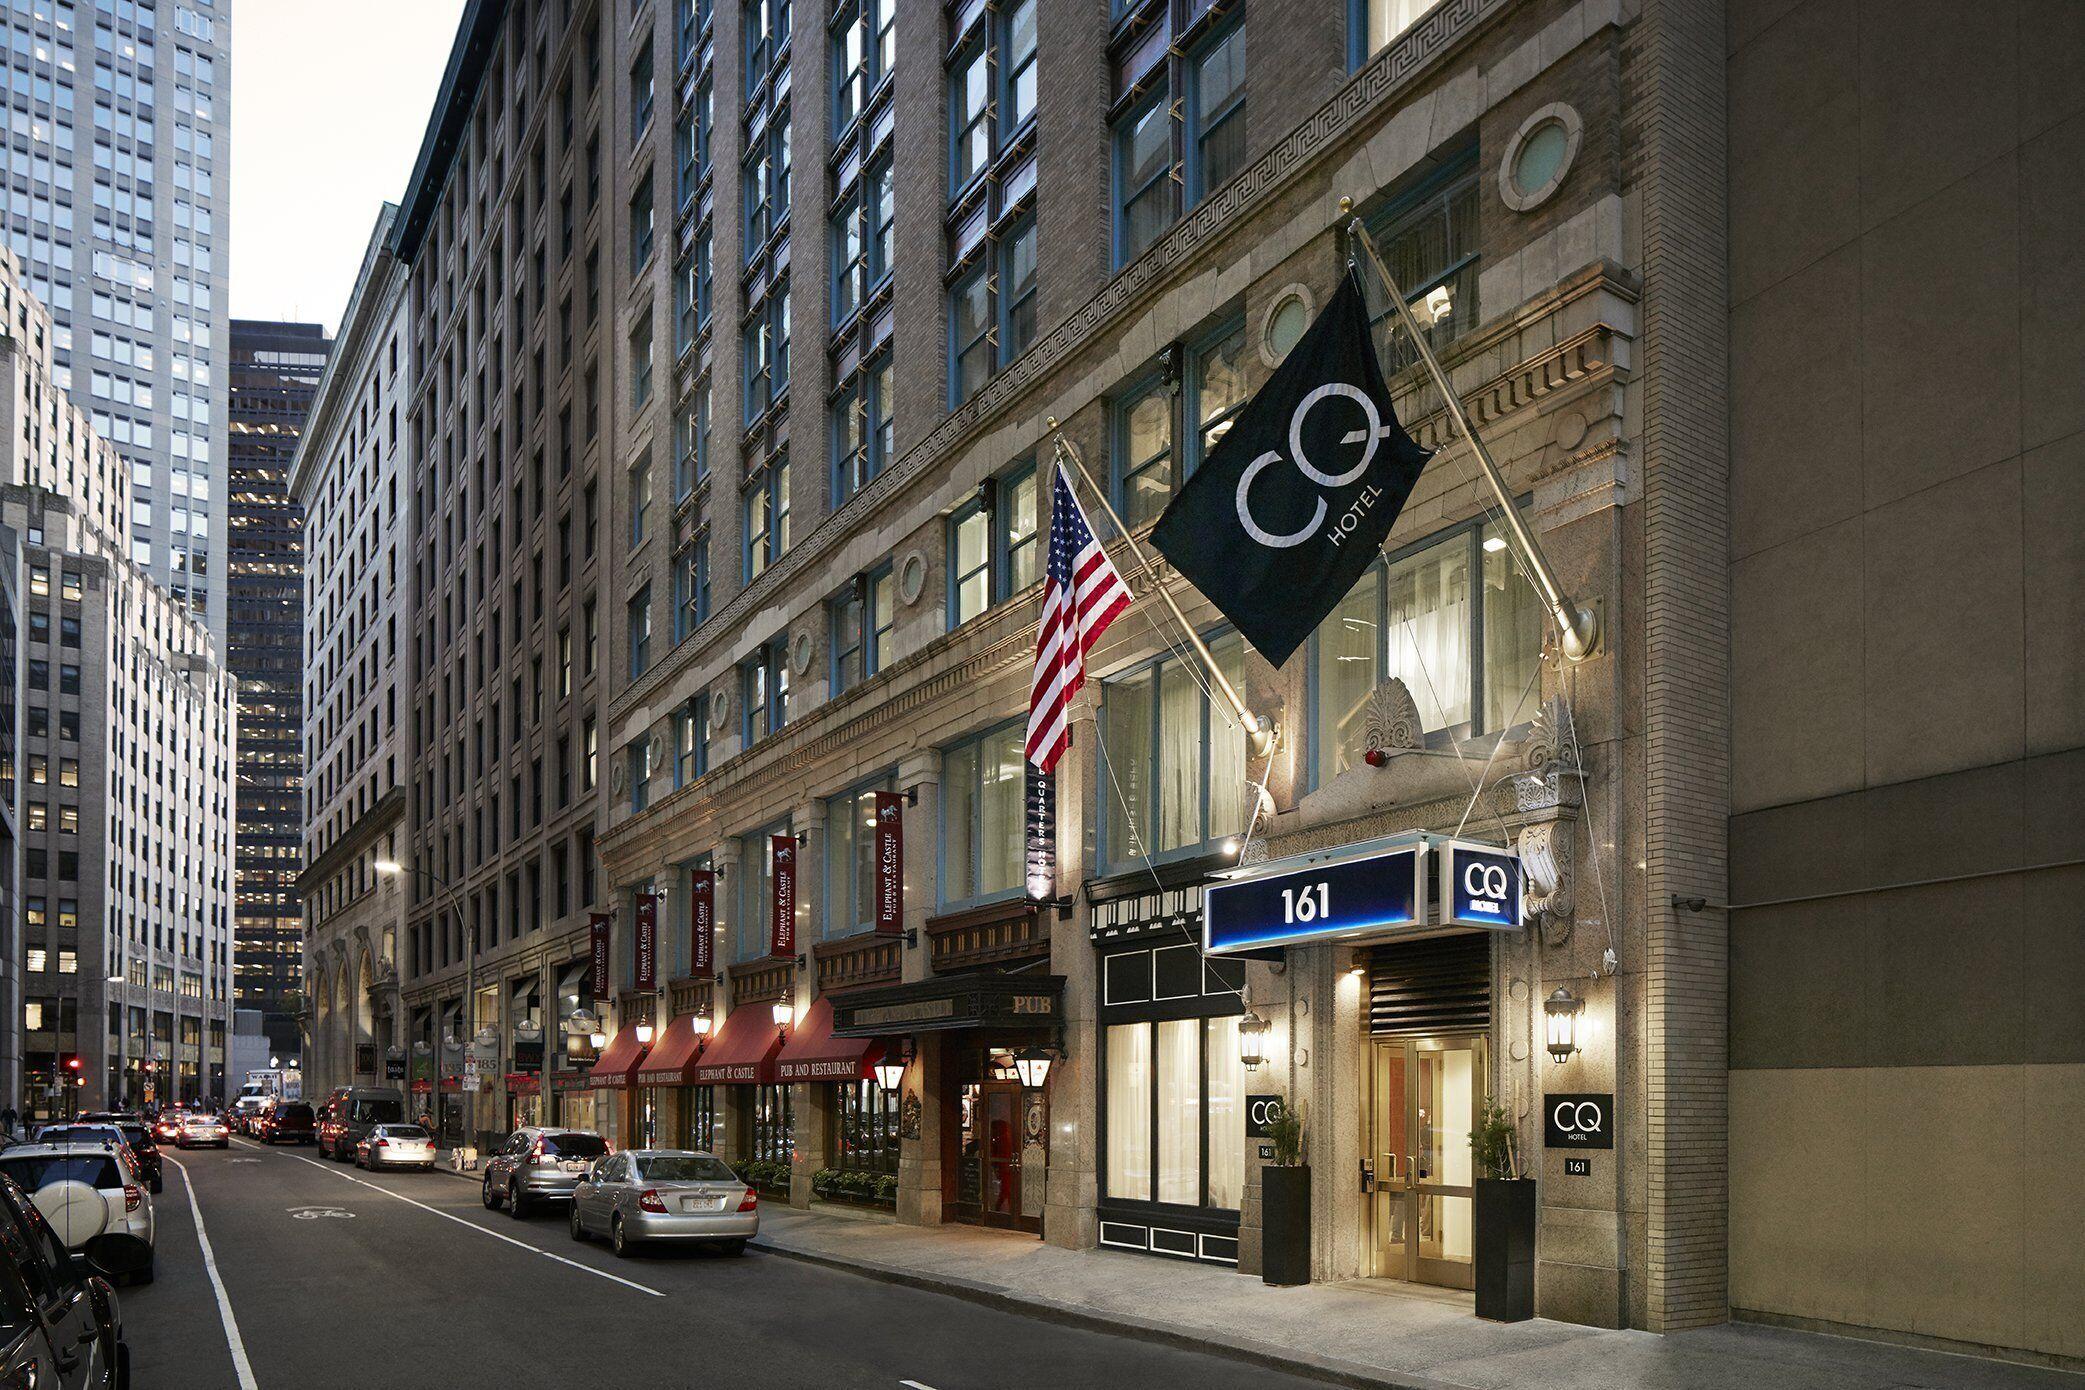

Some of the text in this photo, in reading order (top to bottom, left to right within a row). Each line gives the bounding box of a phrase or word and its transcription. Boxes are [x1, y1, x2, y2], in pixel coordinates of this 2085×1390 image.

[1236, 382, 1390, 548] CQ
[1327, 484, 1383, 547] HOTEL
[1038, 780, 1046, 846] QUARTERS
[882, 833, 892, 921] ELEPHANT & CASTLE
[1464, 862, 1507, 900] CQ
[777, 871, 787, 947] ELEPHANT & CASTLE
[1281, 882, 1329, 924] 161
[697, 925, 704, 933] &
[1013, 995, 1051, 1014] PUB
[476, 1059, 497, 1070] 185
[700, 1066, 755, 1080] ELEPHANT & CASTLE
[780, 1061, 856, 1077] PUB AND RESTAURANT
[1554, 1101, 1601, 1132] CQ
[1569, 1161, 1585, 1172] 161
